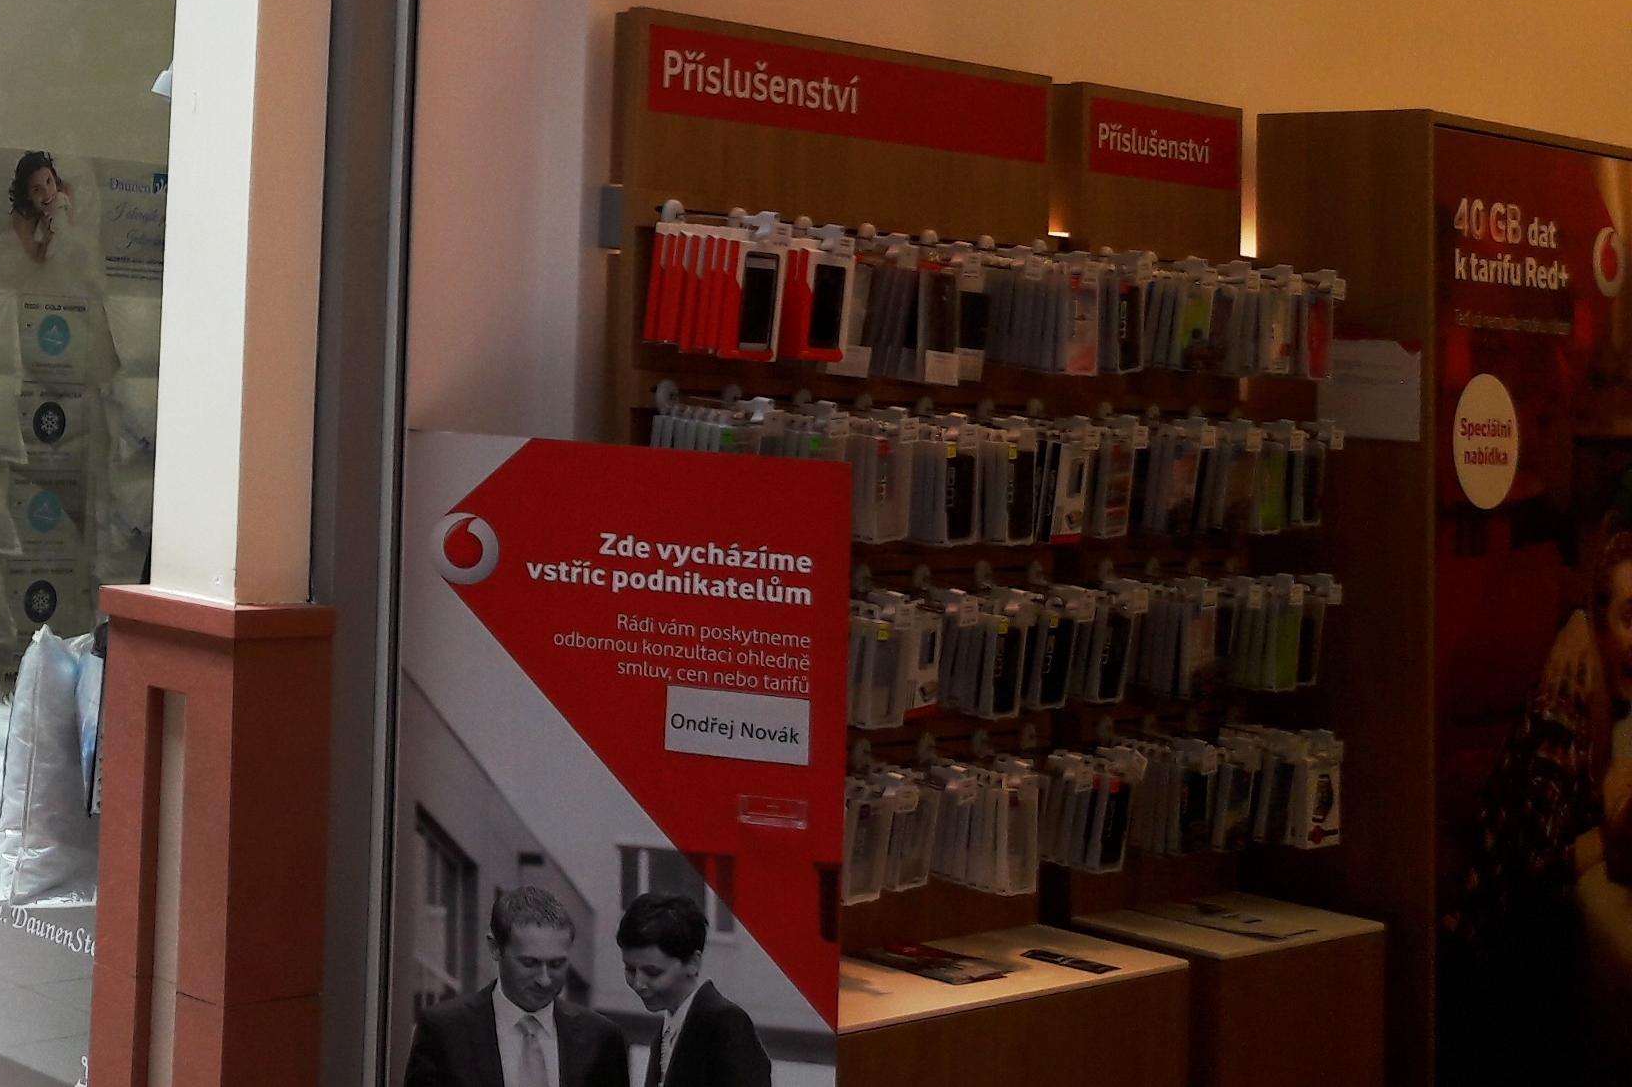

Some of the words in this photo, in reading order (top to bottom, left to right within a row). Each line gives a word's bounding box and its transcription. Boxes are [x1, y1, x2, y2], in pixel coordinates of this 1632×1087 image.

[662, 49, 860, 115] Příslušenství
[1097, 122, 1211, 165] Příslušenství
[1454, 198, 1484, 240] 40
[1489, 202, 1522, 244] GB
[1528, 217, 1556, 249] dat
[1454, 249, 1467, 280] k
[1470, 252, 1521, 286] tarifu
[1525, 257, 1569, 290] Red+
[1460, 418, 1512, 442] Speciální
[1463, 440, 1508, 466] nabídka
[599, 533, 649, 560] Zde
[657, 540, 813, 574] vycházíme
[526, 559, 605, 586] vstříc
[612, 566, 812, 606] podnikatelům
[554, 632, 637, 655] odbornou
[642, 639, 732, 664] konzultaci
[736, 648, 810, 671] ohledně
[617, 614, 654, 634] Rádi
[658, 619, 695, 636] vám
[700, 624, 811, 649] poskytneme
[617, 661, 671, 681] smluv,
[676, 668, 708, 684] cen
[713, 668, 758, 689] nebo
[763, 673, 809, 694] tarifů
[670, 713, 735, 740] Ondřej
[740, 721, 799, 745] Novák
